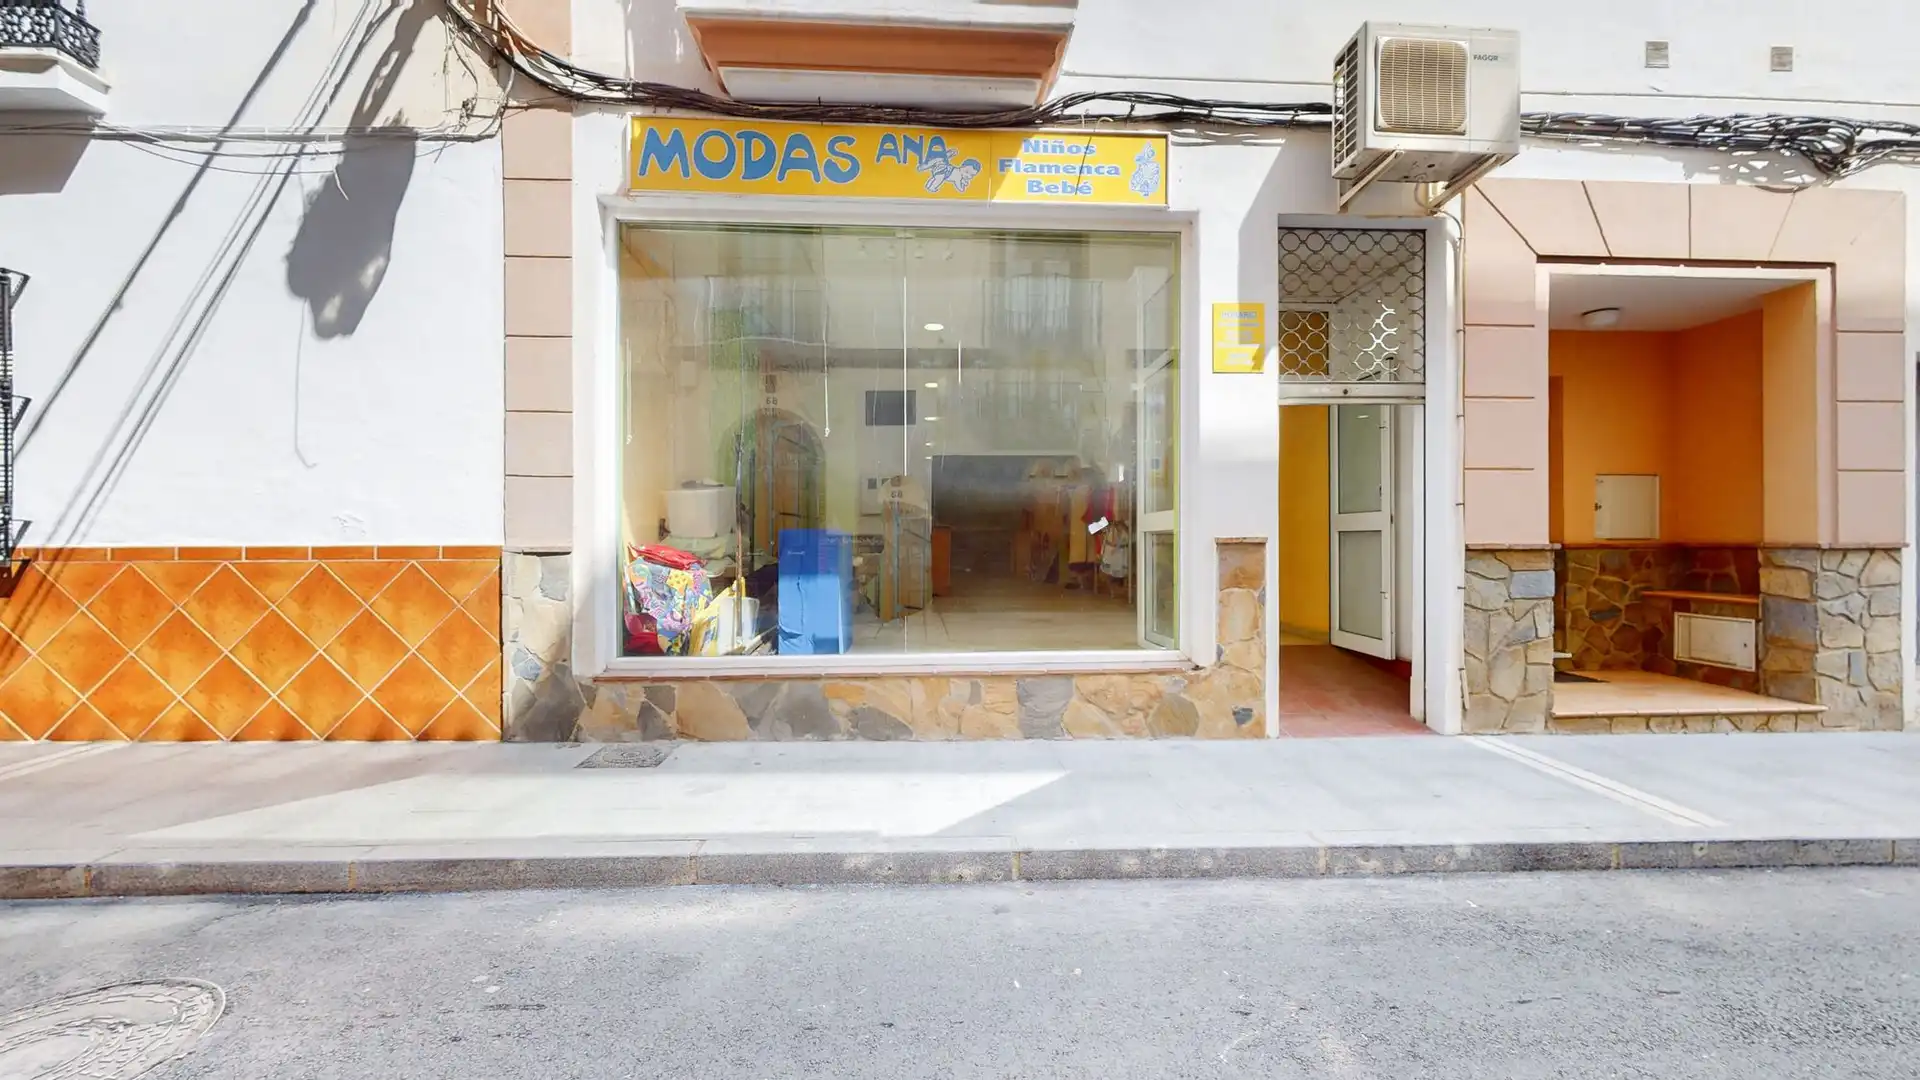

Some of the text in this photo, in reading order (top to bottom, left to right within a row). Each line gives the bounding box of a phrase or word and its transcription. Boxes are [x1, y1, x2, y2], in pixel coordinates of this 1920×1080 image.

[638, 127, 949, 184] MODAS ANA
[1021, 139, 1097, 155] Niños
[997, 158, 1121, 176] Flamenca
[1026, 179, 1093, 195] Bebé
